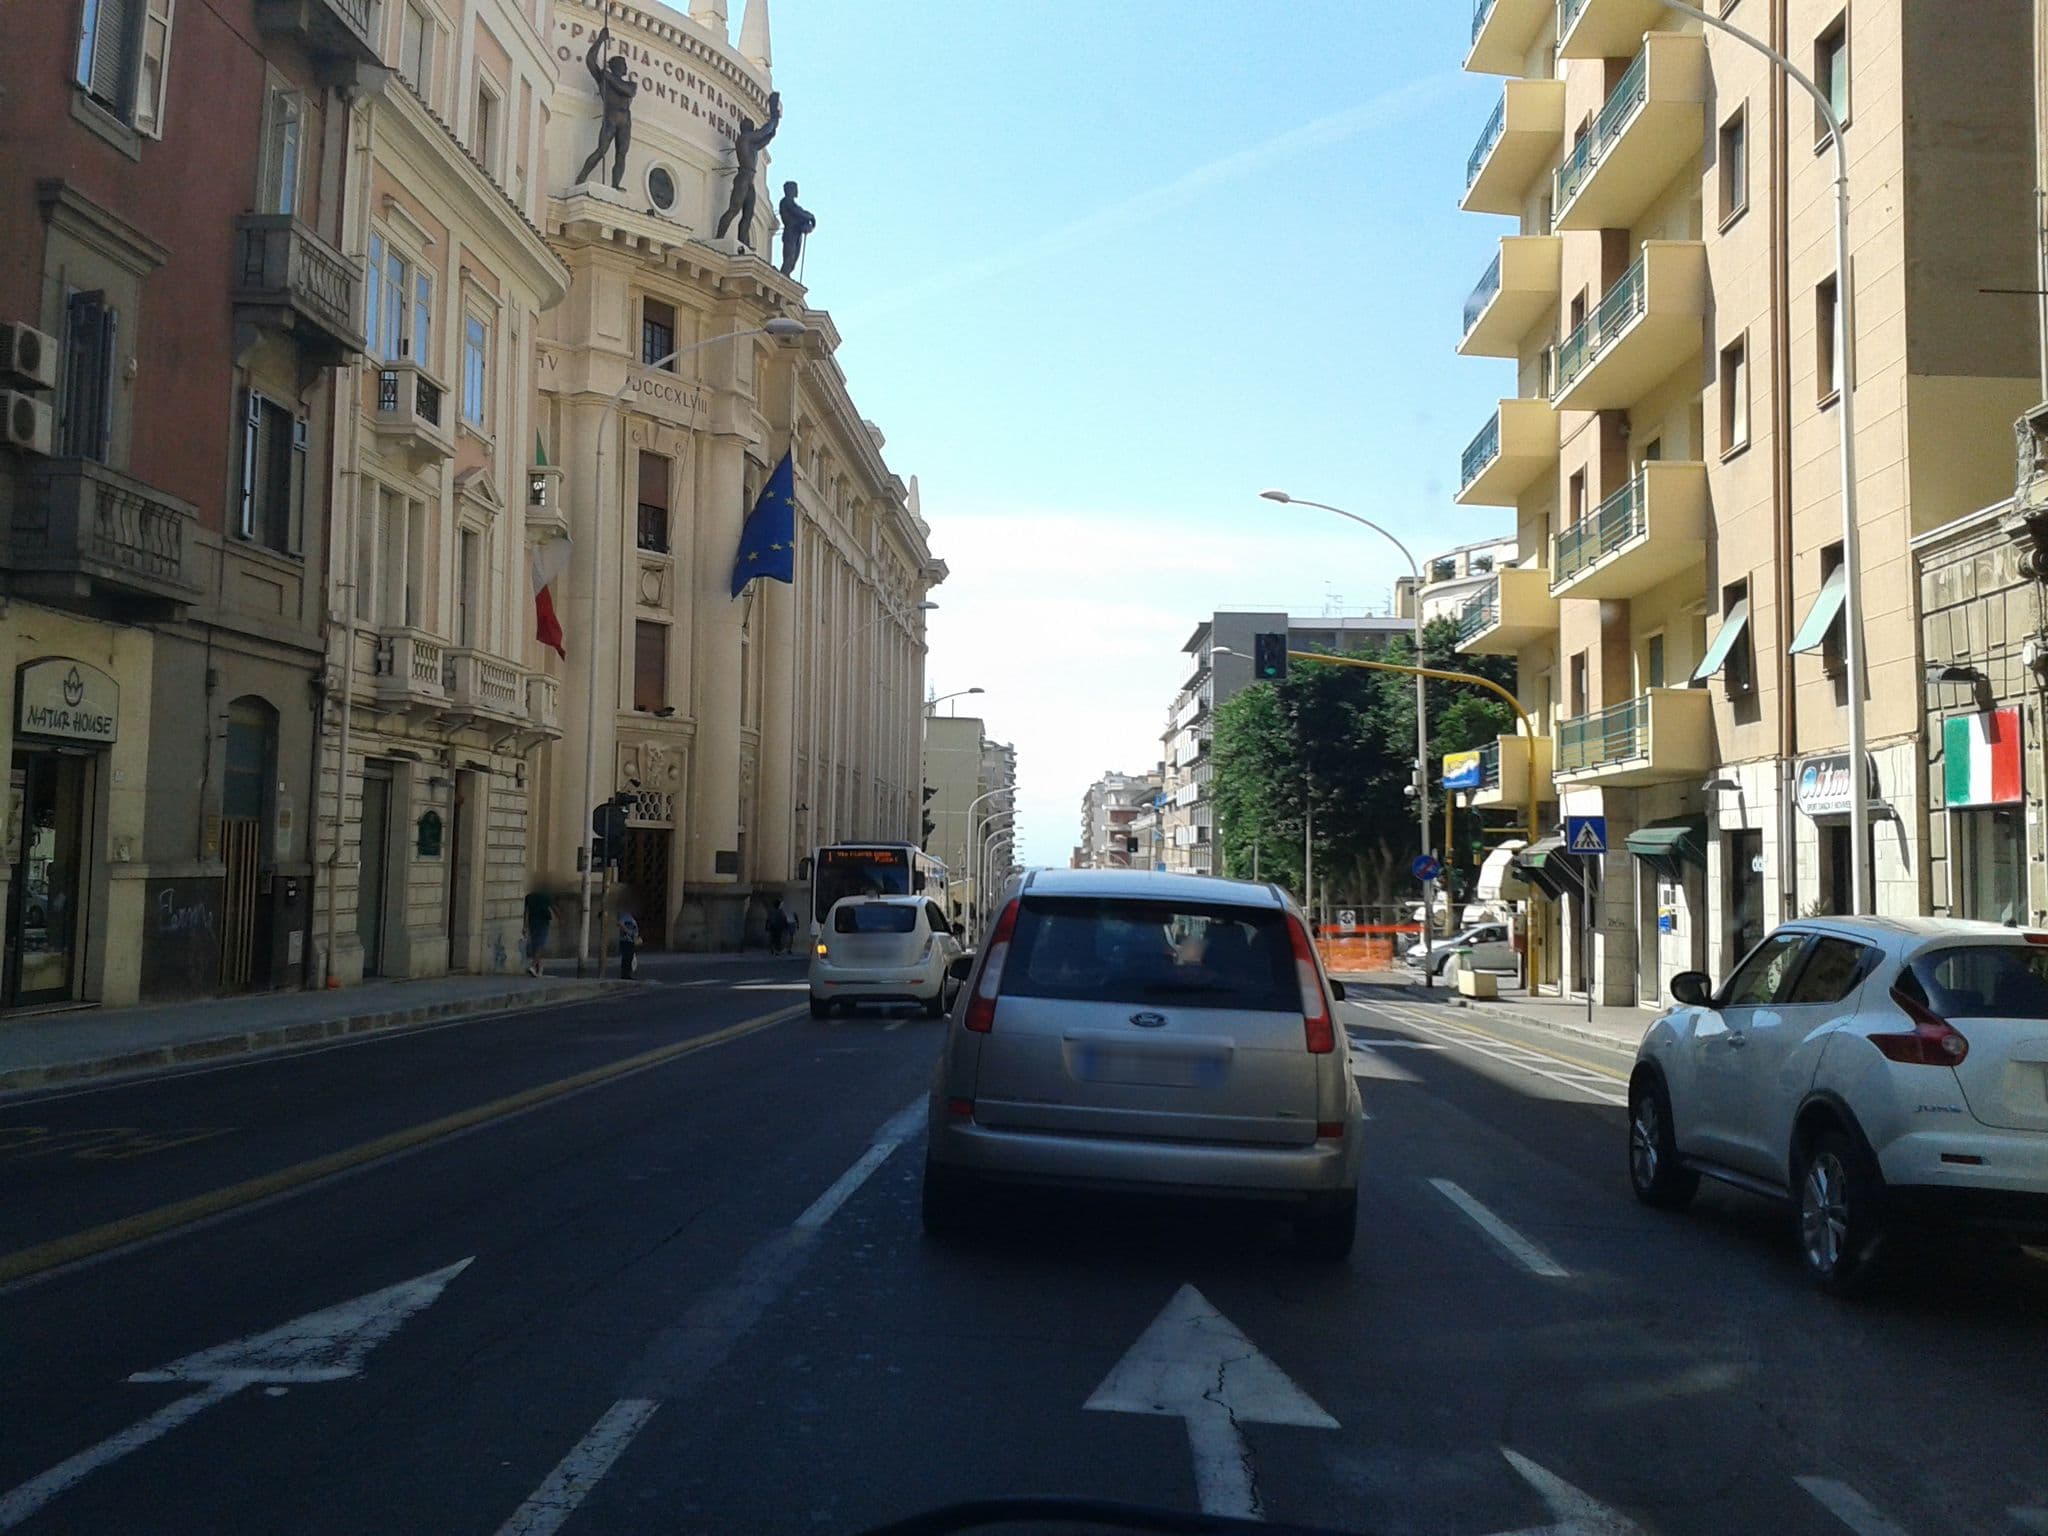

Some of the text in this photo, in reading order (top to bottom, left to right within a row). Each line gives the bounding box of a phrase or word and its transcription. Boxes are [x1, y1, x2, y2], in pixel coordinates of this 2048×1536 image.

[663, 62, 723, 108] CONTRA
[27, 705, 112, 735] NATUR HOUSE
